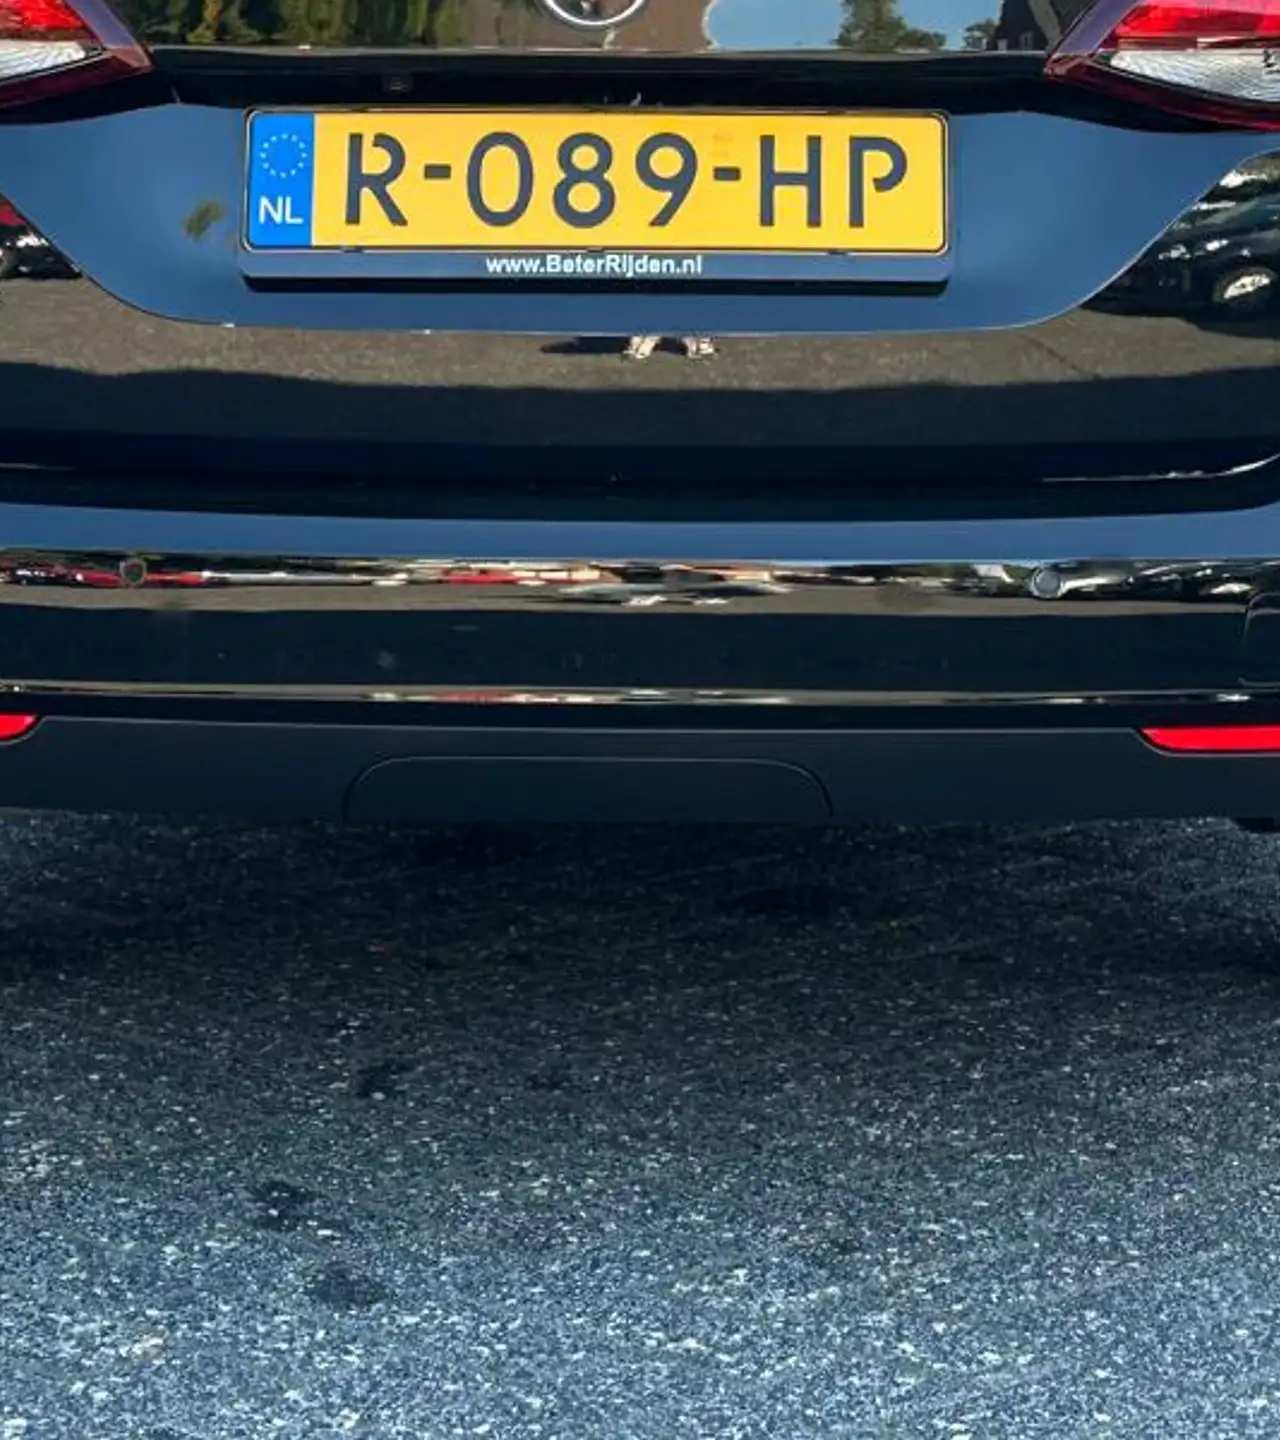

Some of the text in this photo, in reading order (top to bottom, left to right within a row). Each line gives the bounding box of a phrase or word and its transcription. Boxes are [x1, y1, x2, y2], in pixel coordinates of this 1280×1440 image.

[344, 131, 909, 228] R-089-HP
[258, 195, 304, 225] NL
[485, 254, 703, 278] www.BeterRijden.nl
